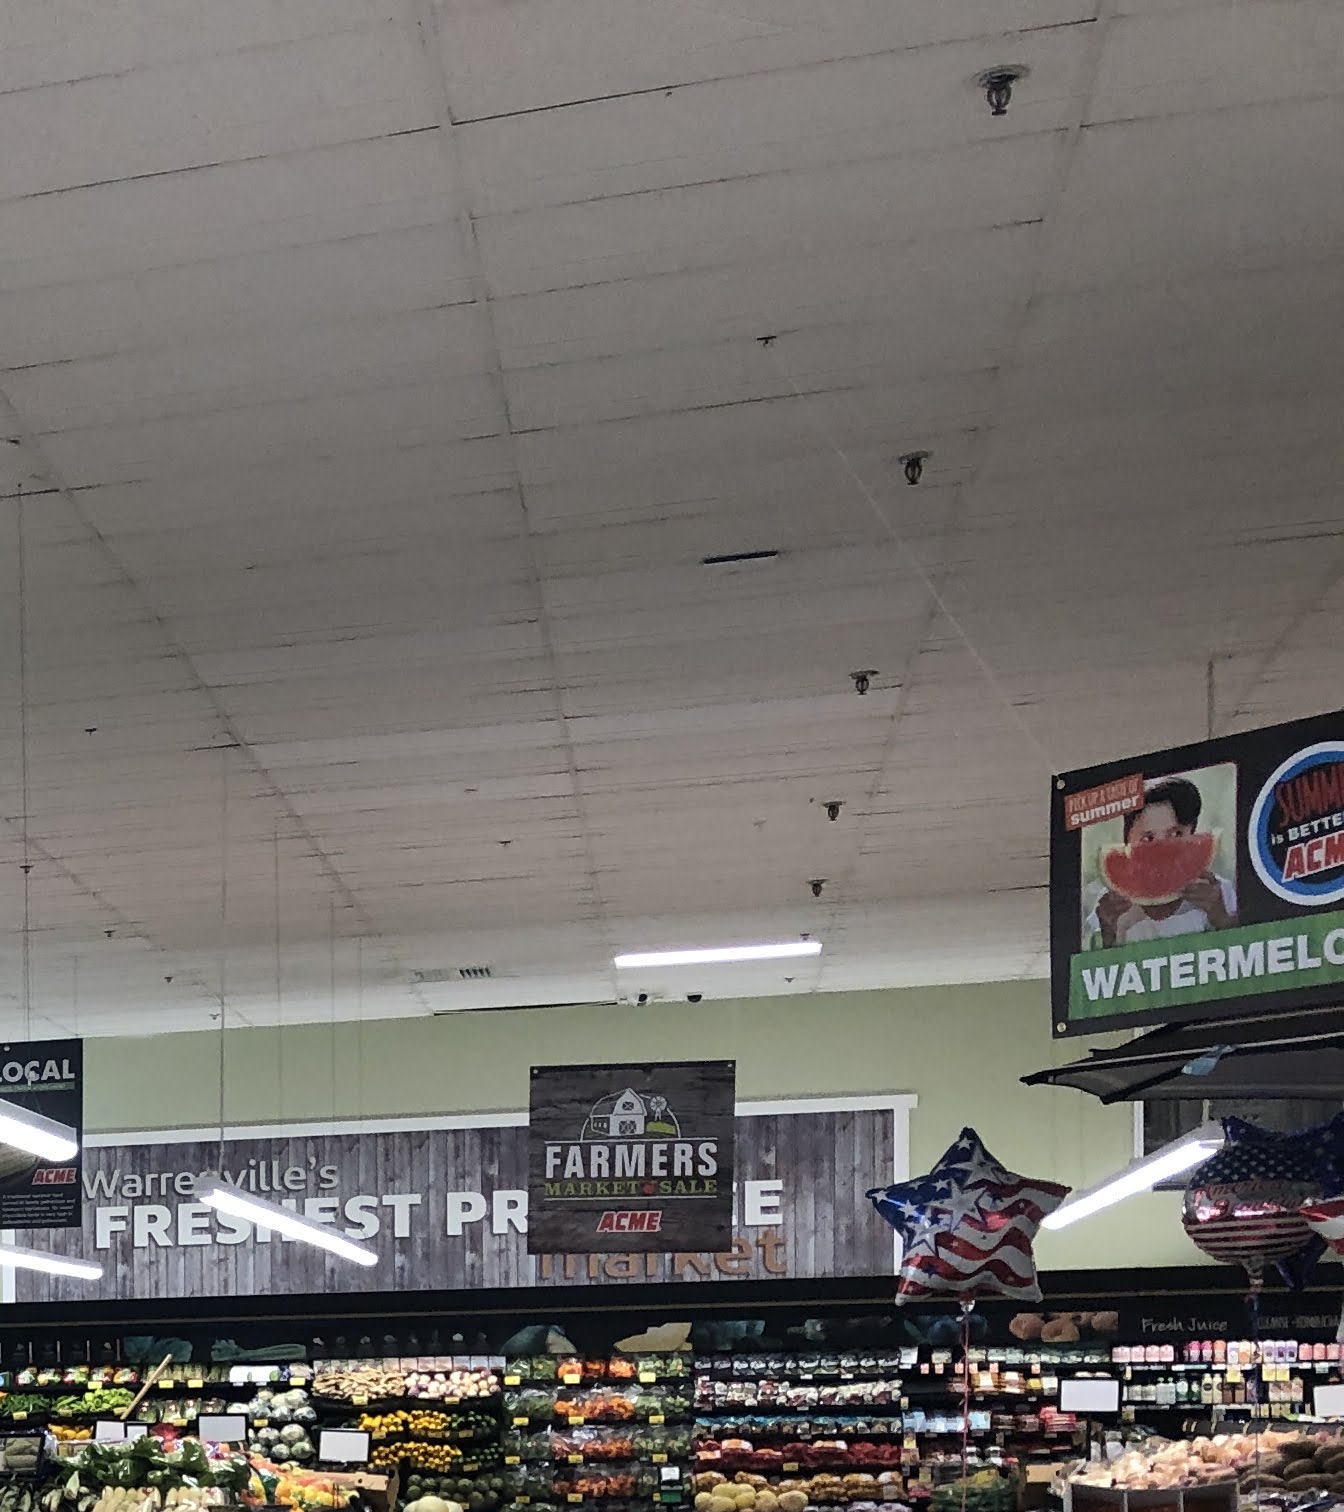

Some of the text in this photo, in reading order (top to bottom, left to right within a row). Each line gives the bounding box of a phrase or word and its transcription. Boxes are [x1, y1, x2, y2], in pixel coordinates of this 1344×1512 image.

[1071, 795, 1139, 825] summer
[545, 1142, 718, 1179] FARMERS
[32, 1167, 77, 1185] ACME
[84, 1157, 338, 1199] Warreville's
[544, 1179, 718, 1196] MARKET SALE
[597, 1211, 662, 1233] ACME
[1142, 1316, 1229, 1332] Fresh Juice
